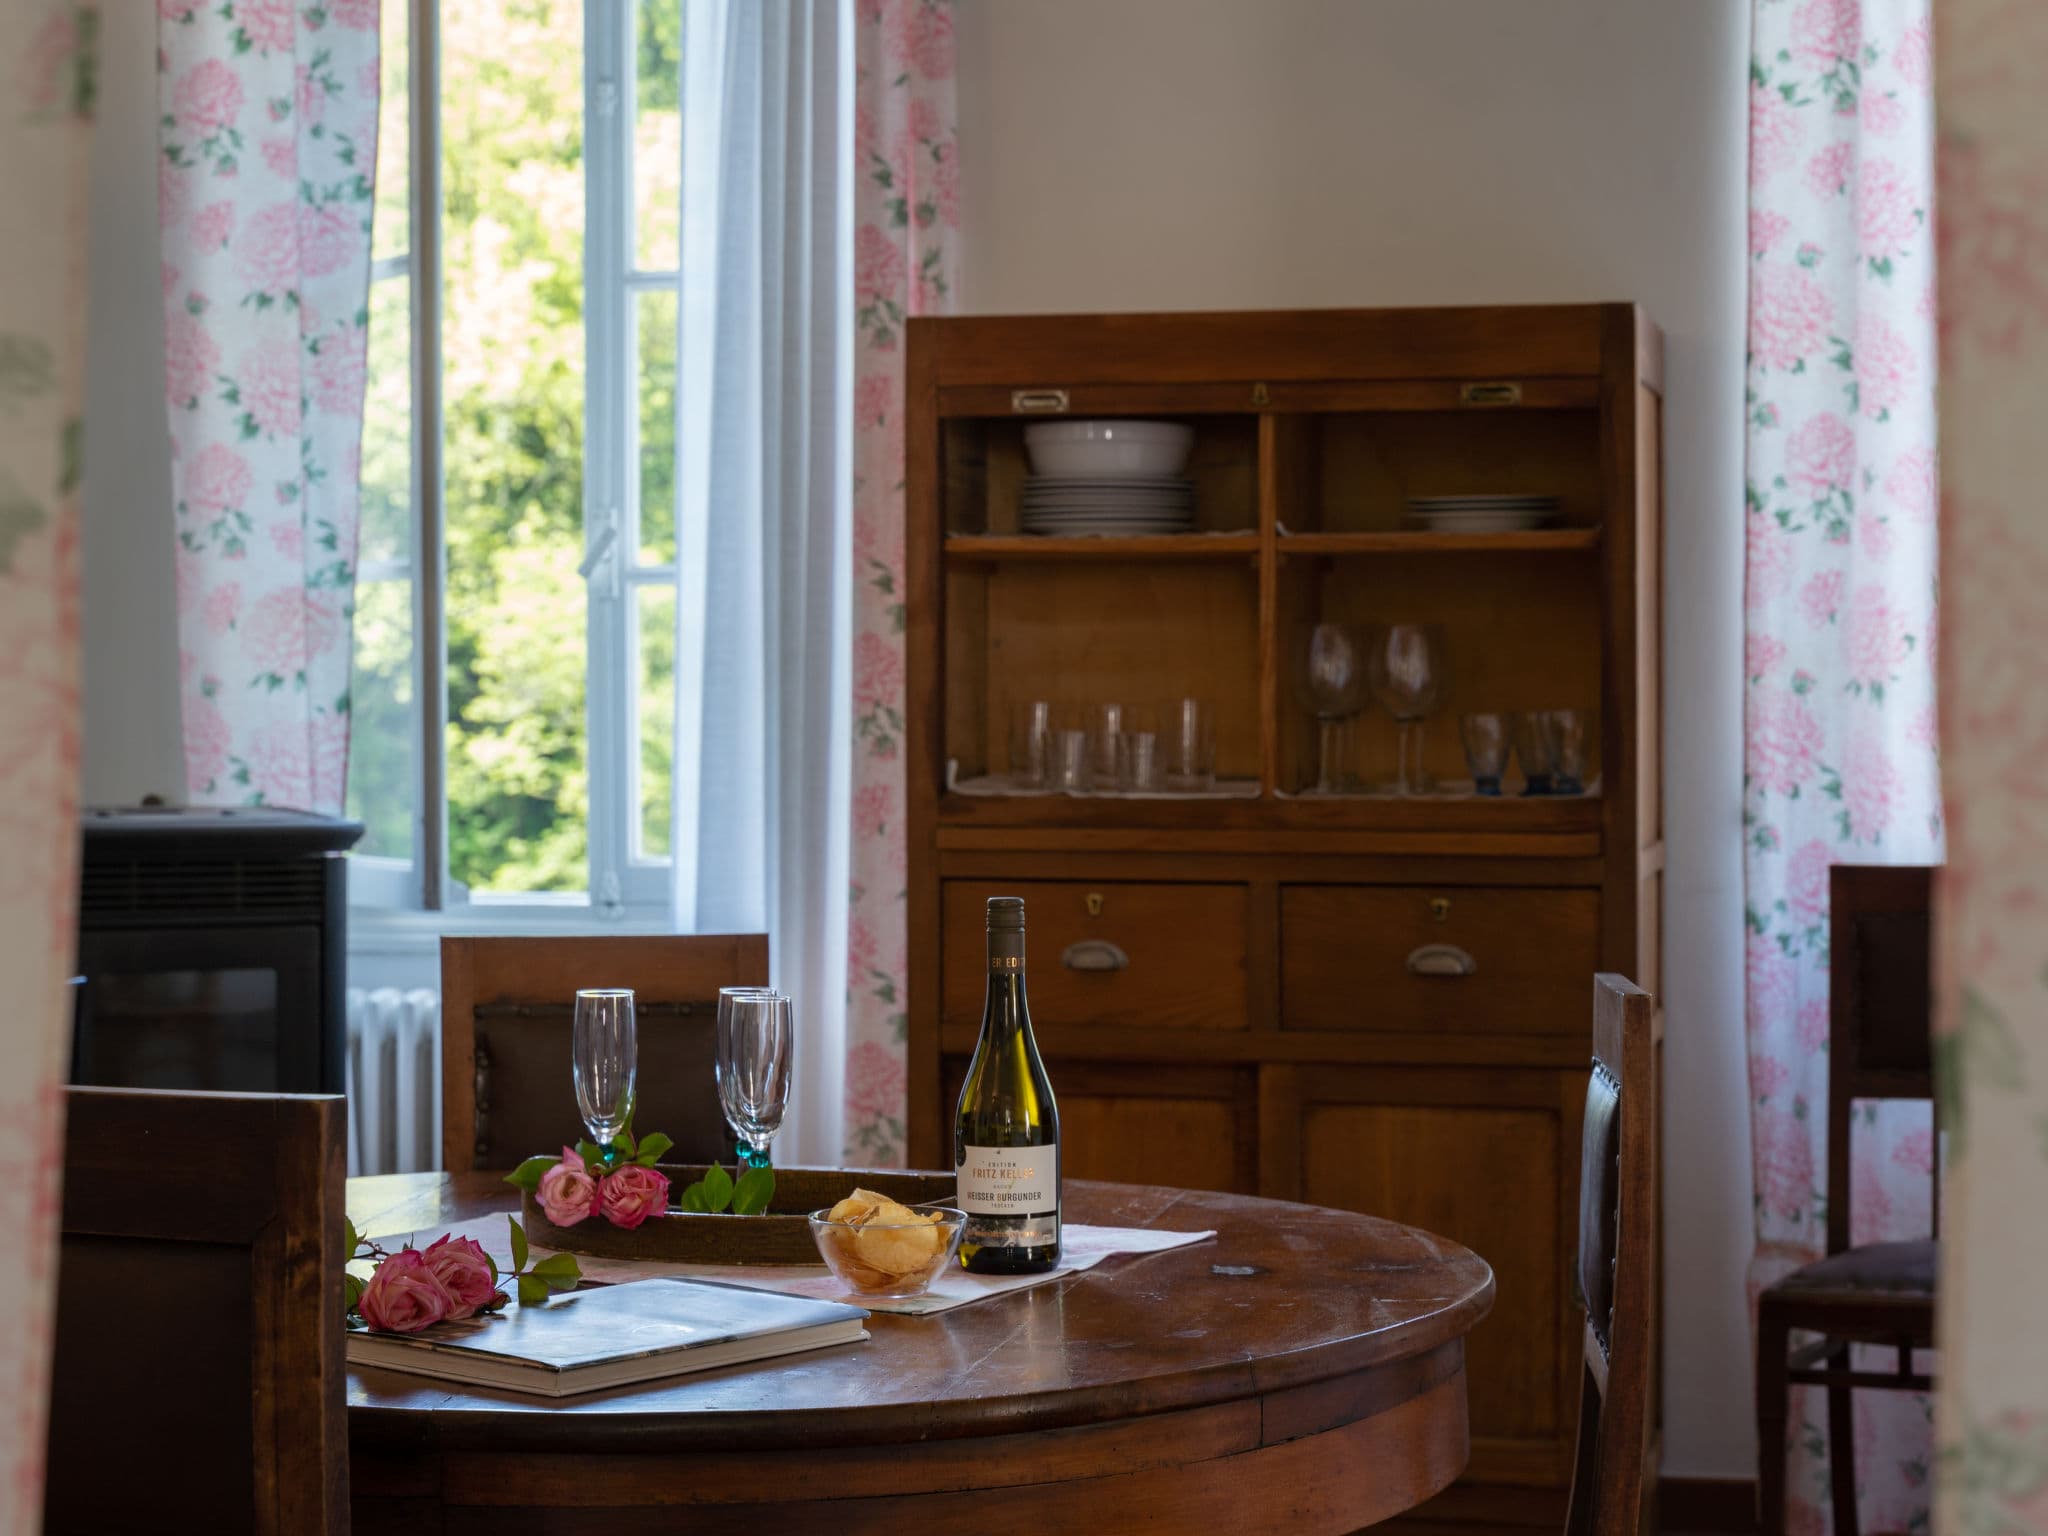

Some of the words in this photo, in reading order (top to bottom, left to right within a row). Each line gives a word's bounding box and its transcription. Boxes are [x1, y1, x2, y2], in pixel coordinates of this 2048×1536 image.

[972, 1168, 996, 1179] FRITZ
[967, 1191, 995, 1202] WEISSER
[997, 1191, 1042, 1202] BURGUNDER
